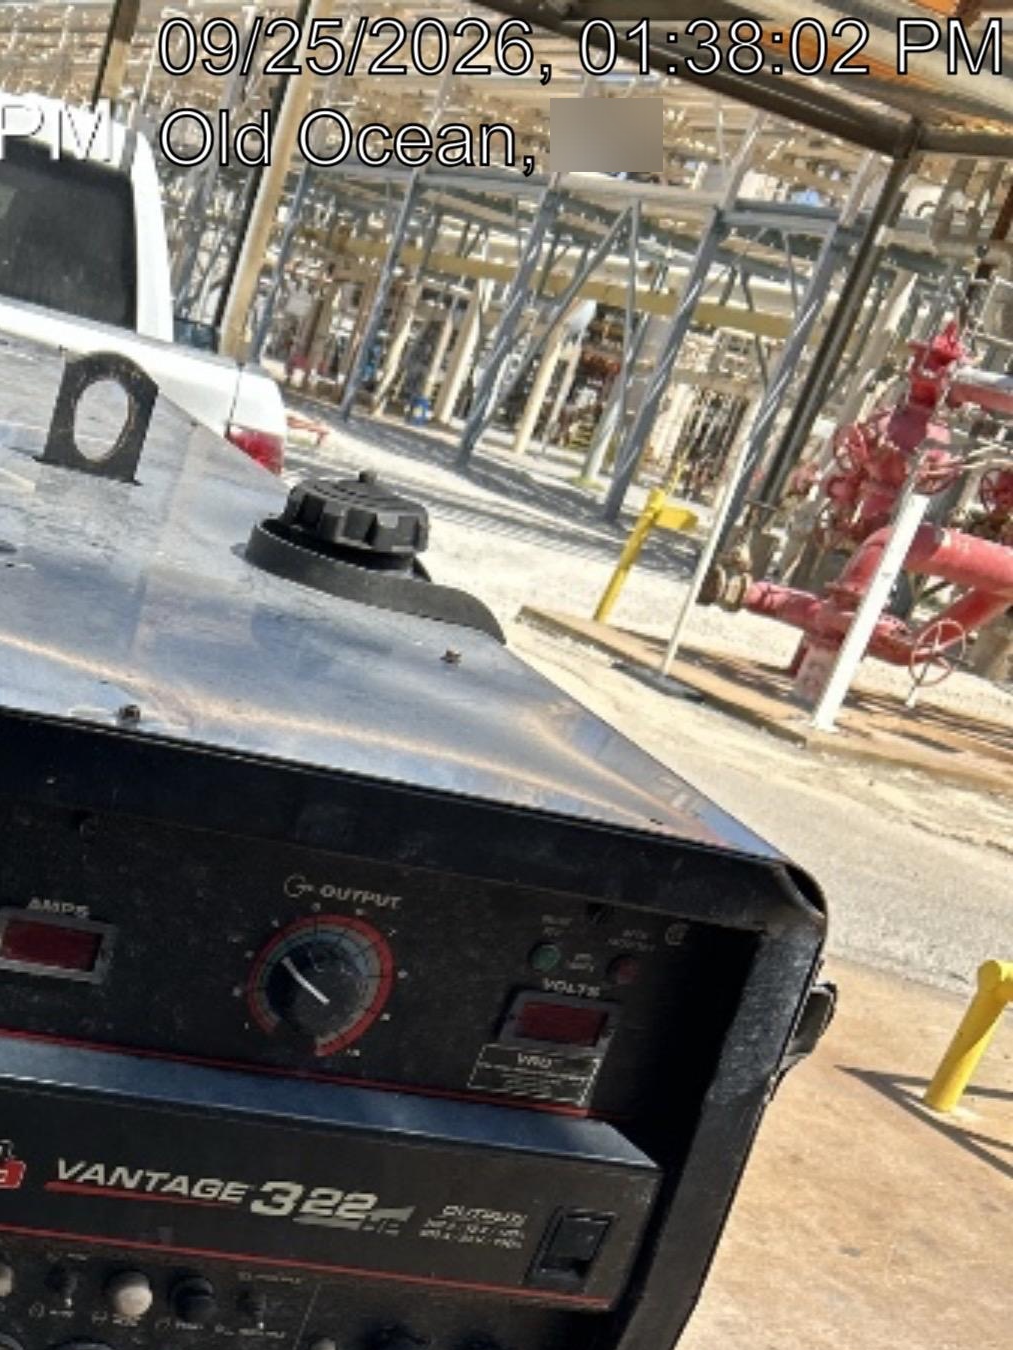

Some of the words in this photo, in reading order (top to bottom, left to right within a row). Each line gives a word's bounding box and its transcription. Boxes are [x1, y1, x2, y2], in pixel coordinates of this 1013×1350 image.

[320, 885, 403, 909] OUTPUT
[56, 1157, 252, 1204] VANTAGE
[250, 1180, 379, 1220] 322
